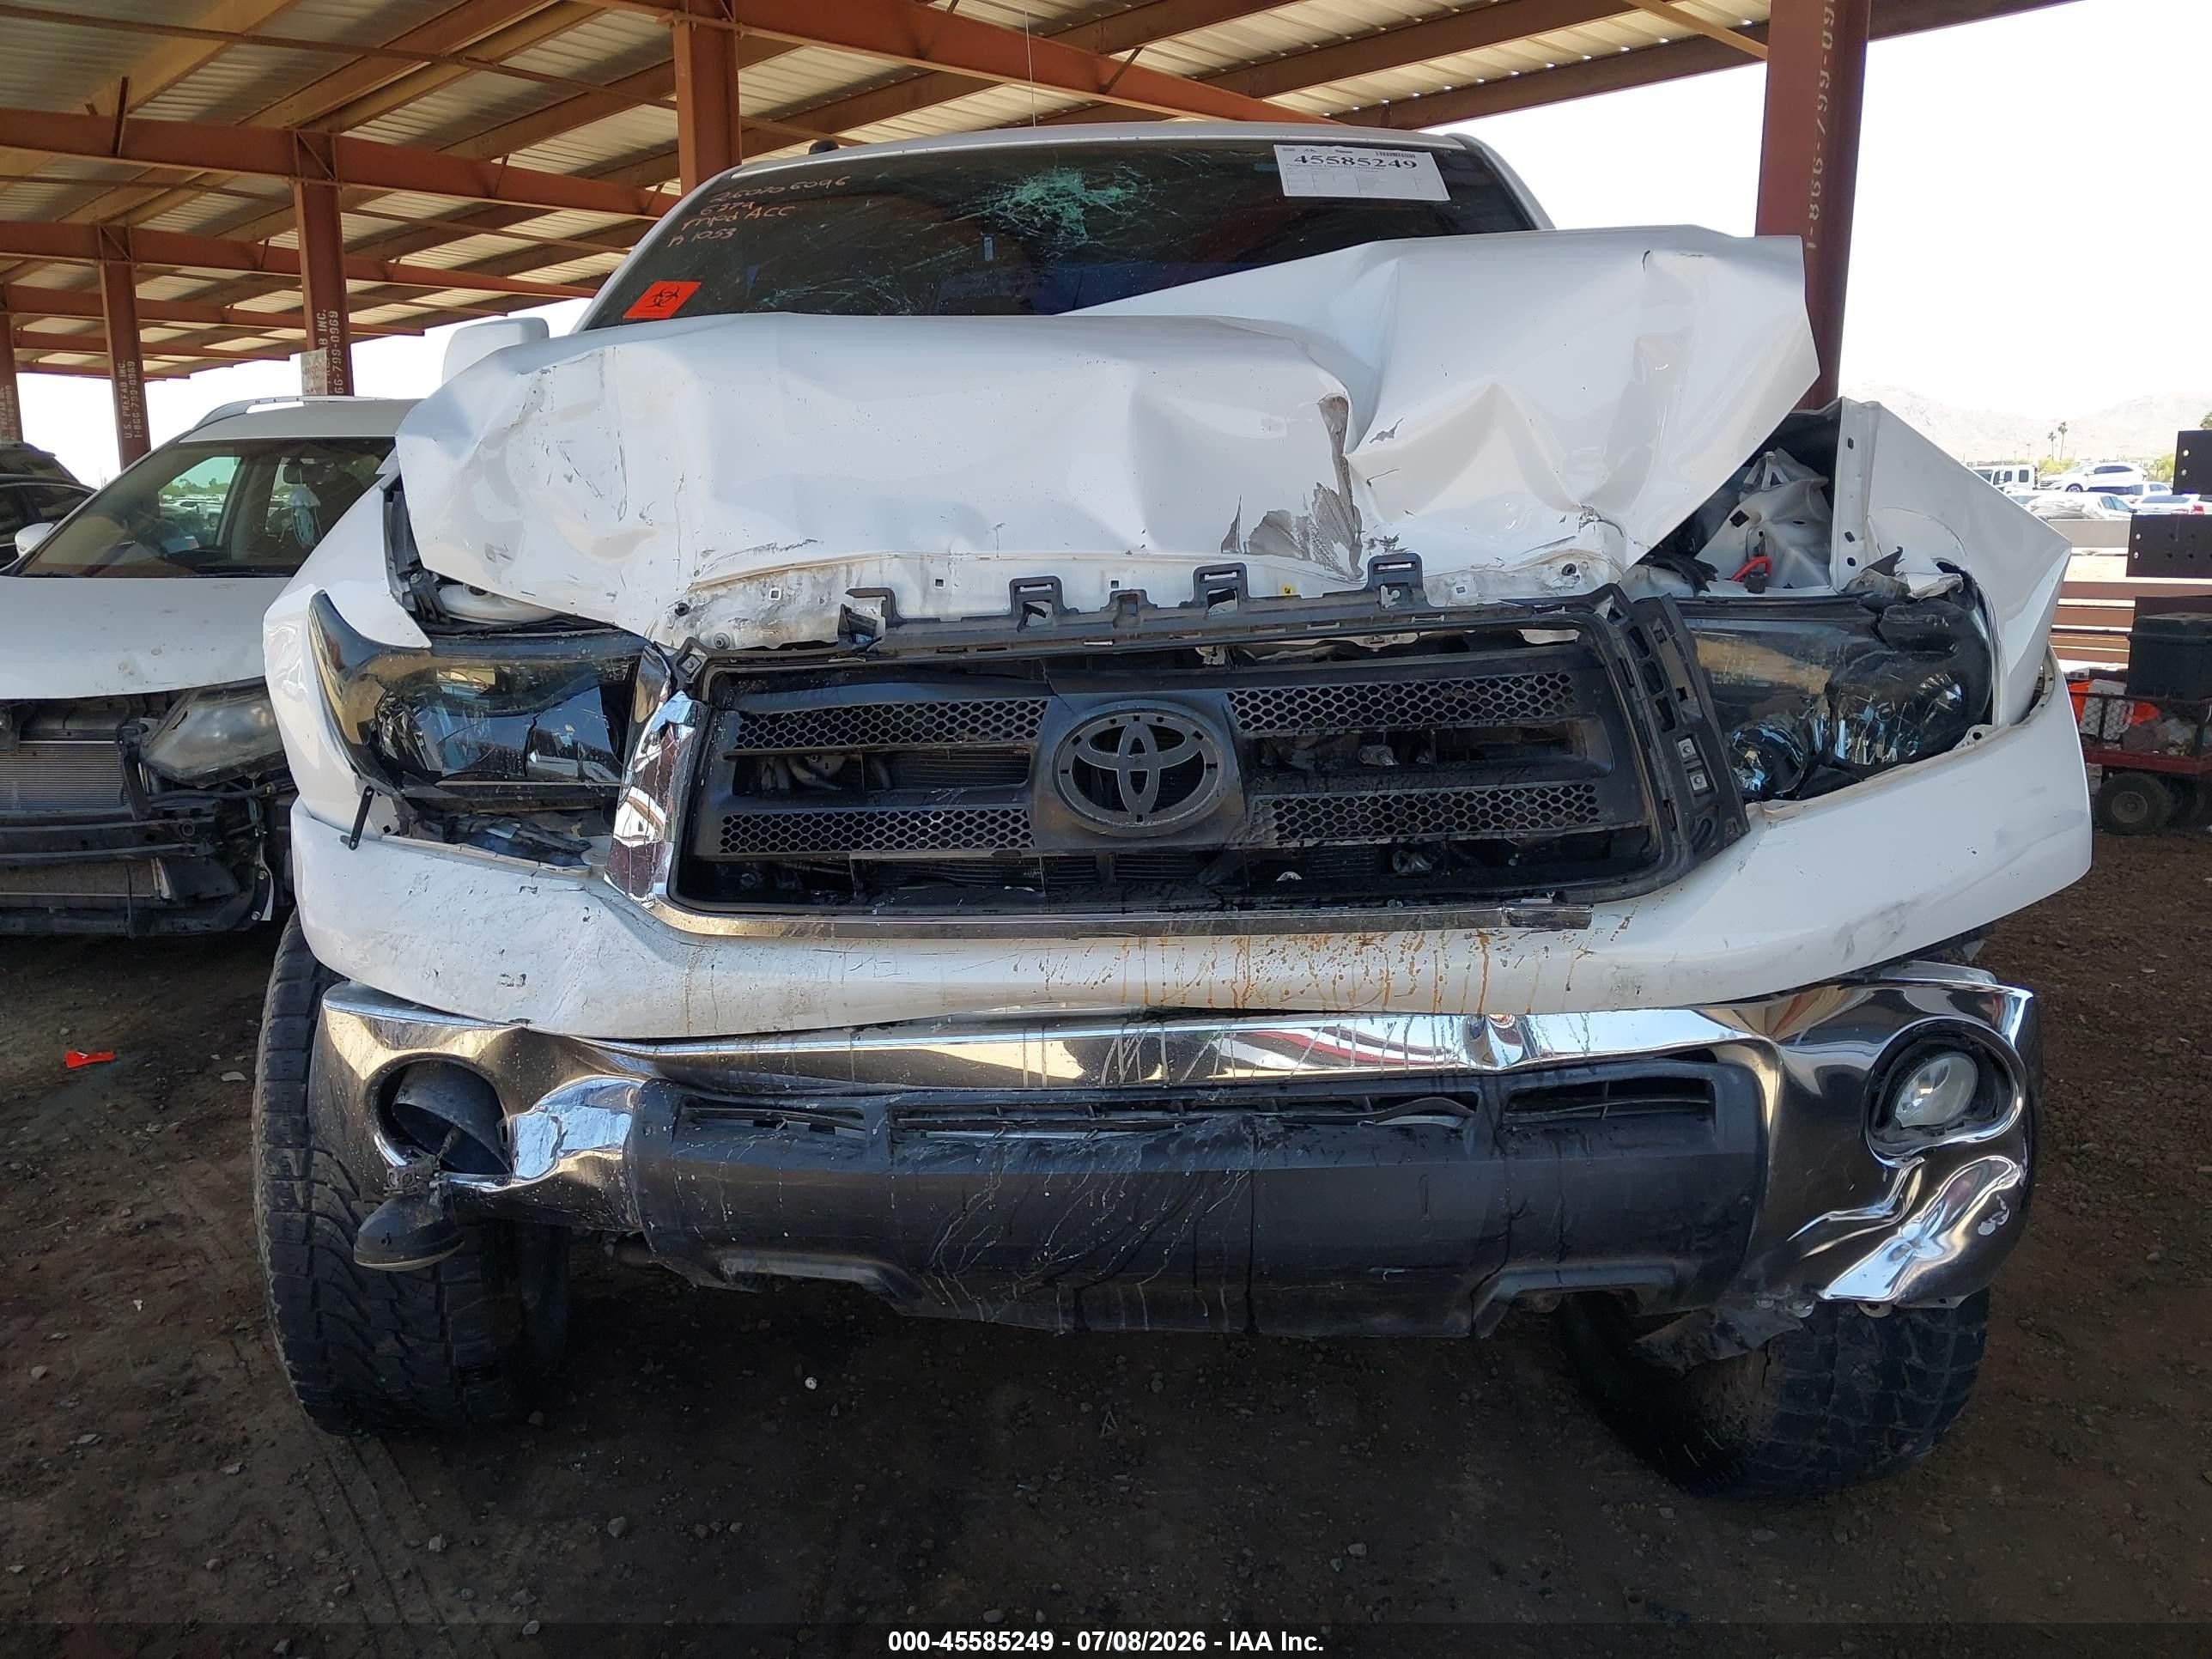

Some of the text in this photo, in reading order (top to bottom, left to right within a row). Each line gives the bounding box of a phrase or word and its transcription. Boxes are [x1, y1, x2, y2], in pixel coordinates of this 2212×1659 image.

[1294, 155, 1418, 170] 45585249
[316, 308, 327, 332] INC.
[118, 381, 131, 417] PREFAB
